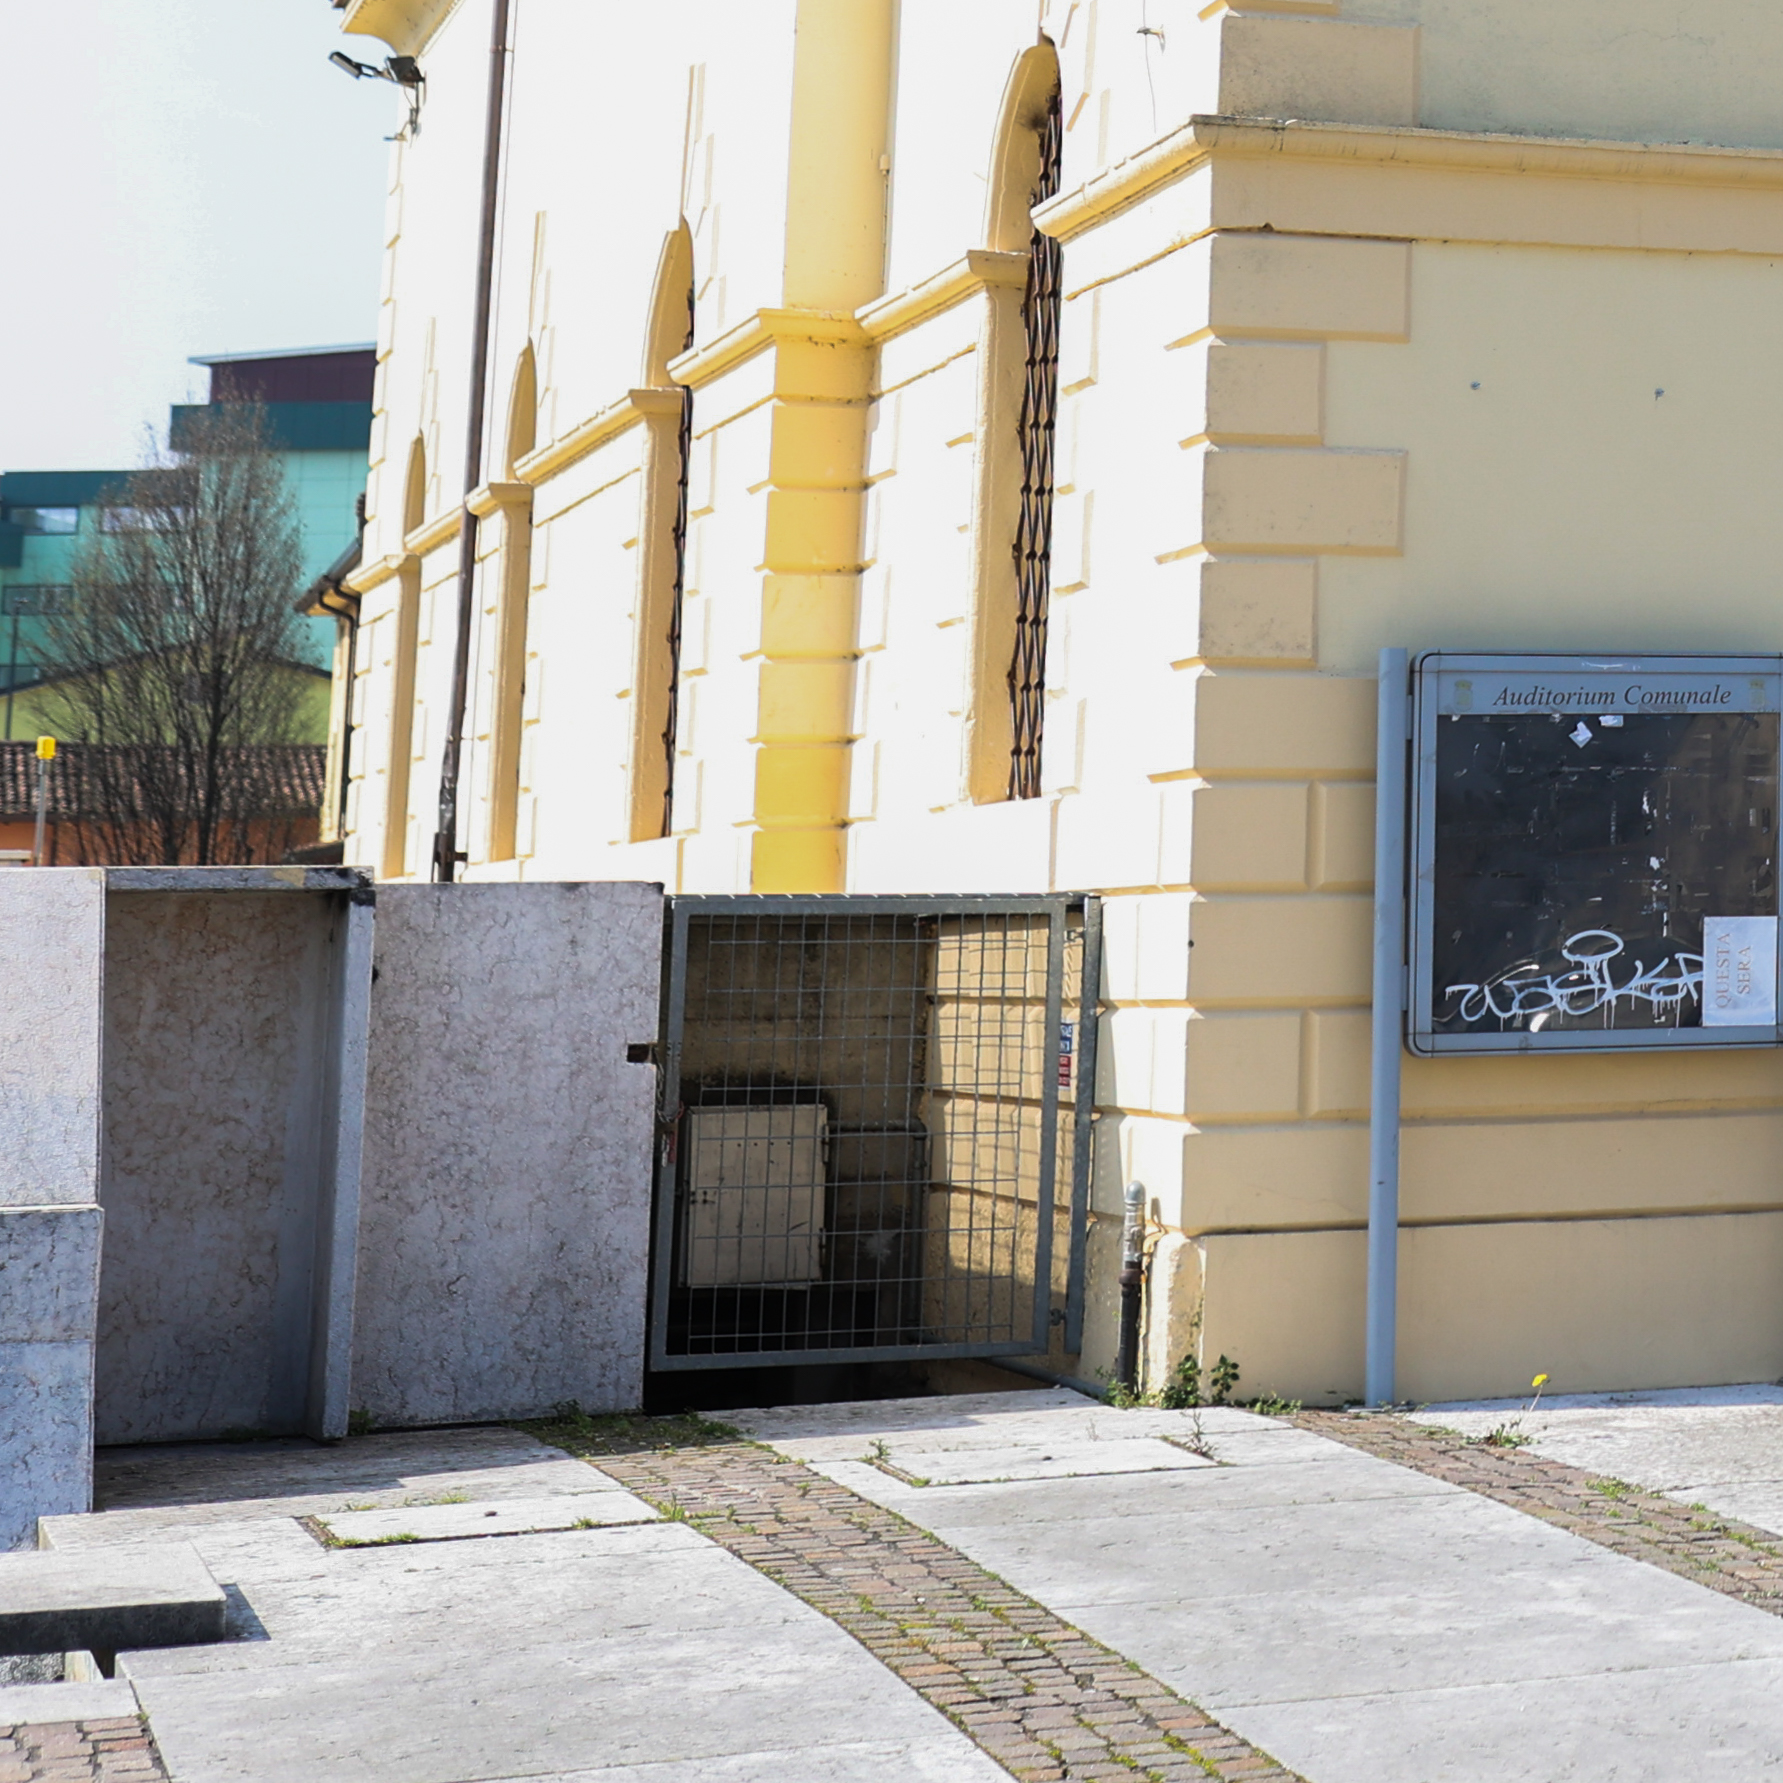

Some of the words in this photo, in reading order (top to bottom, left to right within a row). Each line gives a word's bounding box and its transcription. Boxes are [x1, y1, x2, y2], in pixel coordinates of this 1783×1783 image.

[1493, 685, 1615, 706] Auditorium
[1624, 684, 1731, 706] Comunale
[1716, 933, 1731, 1009] QUESTA
[1737, 946, 1751, 994] SERA
